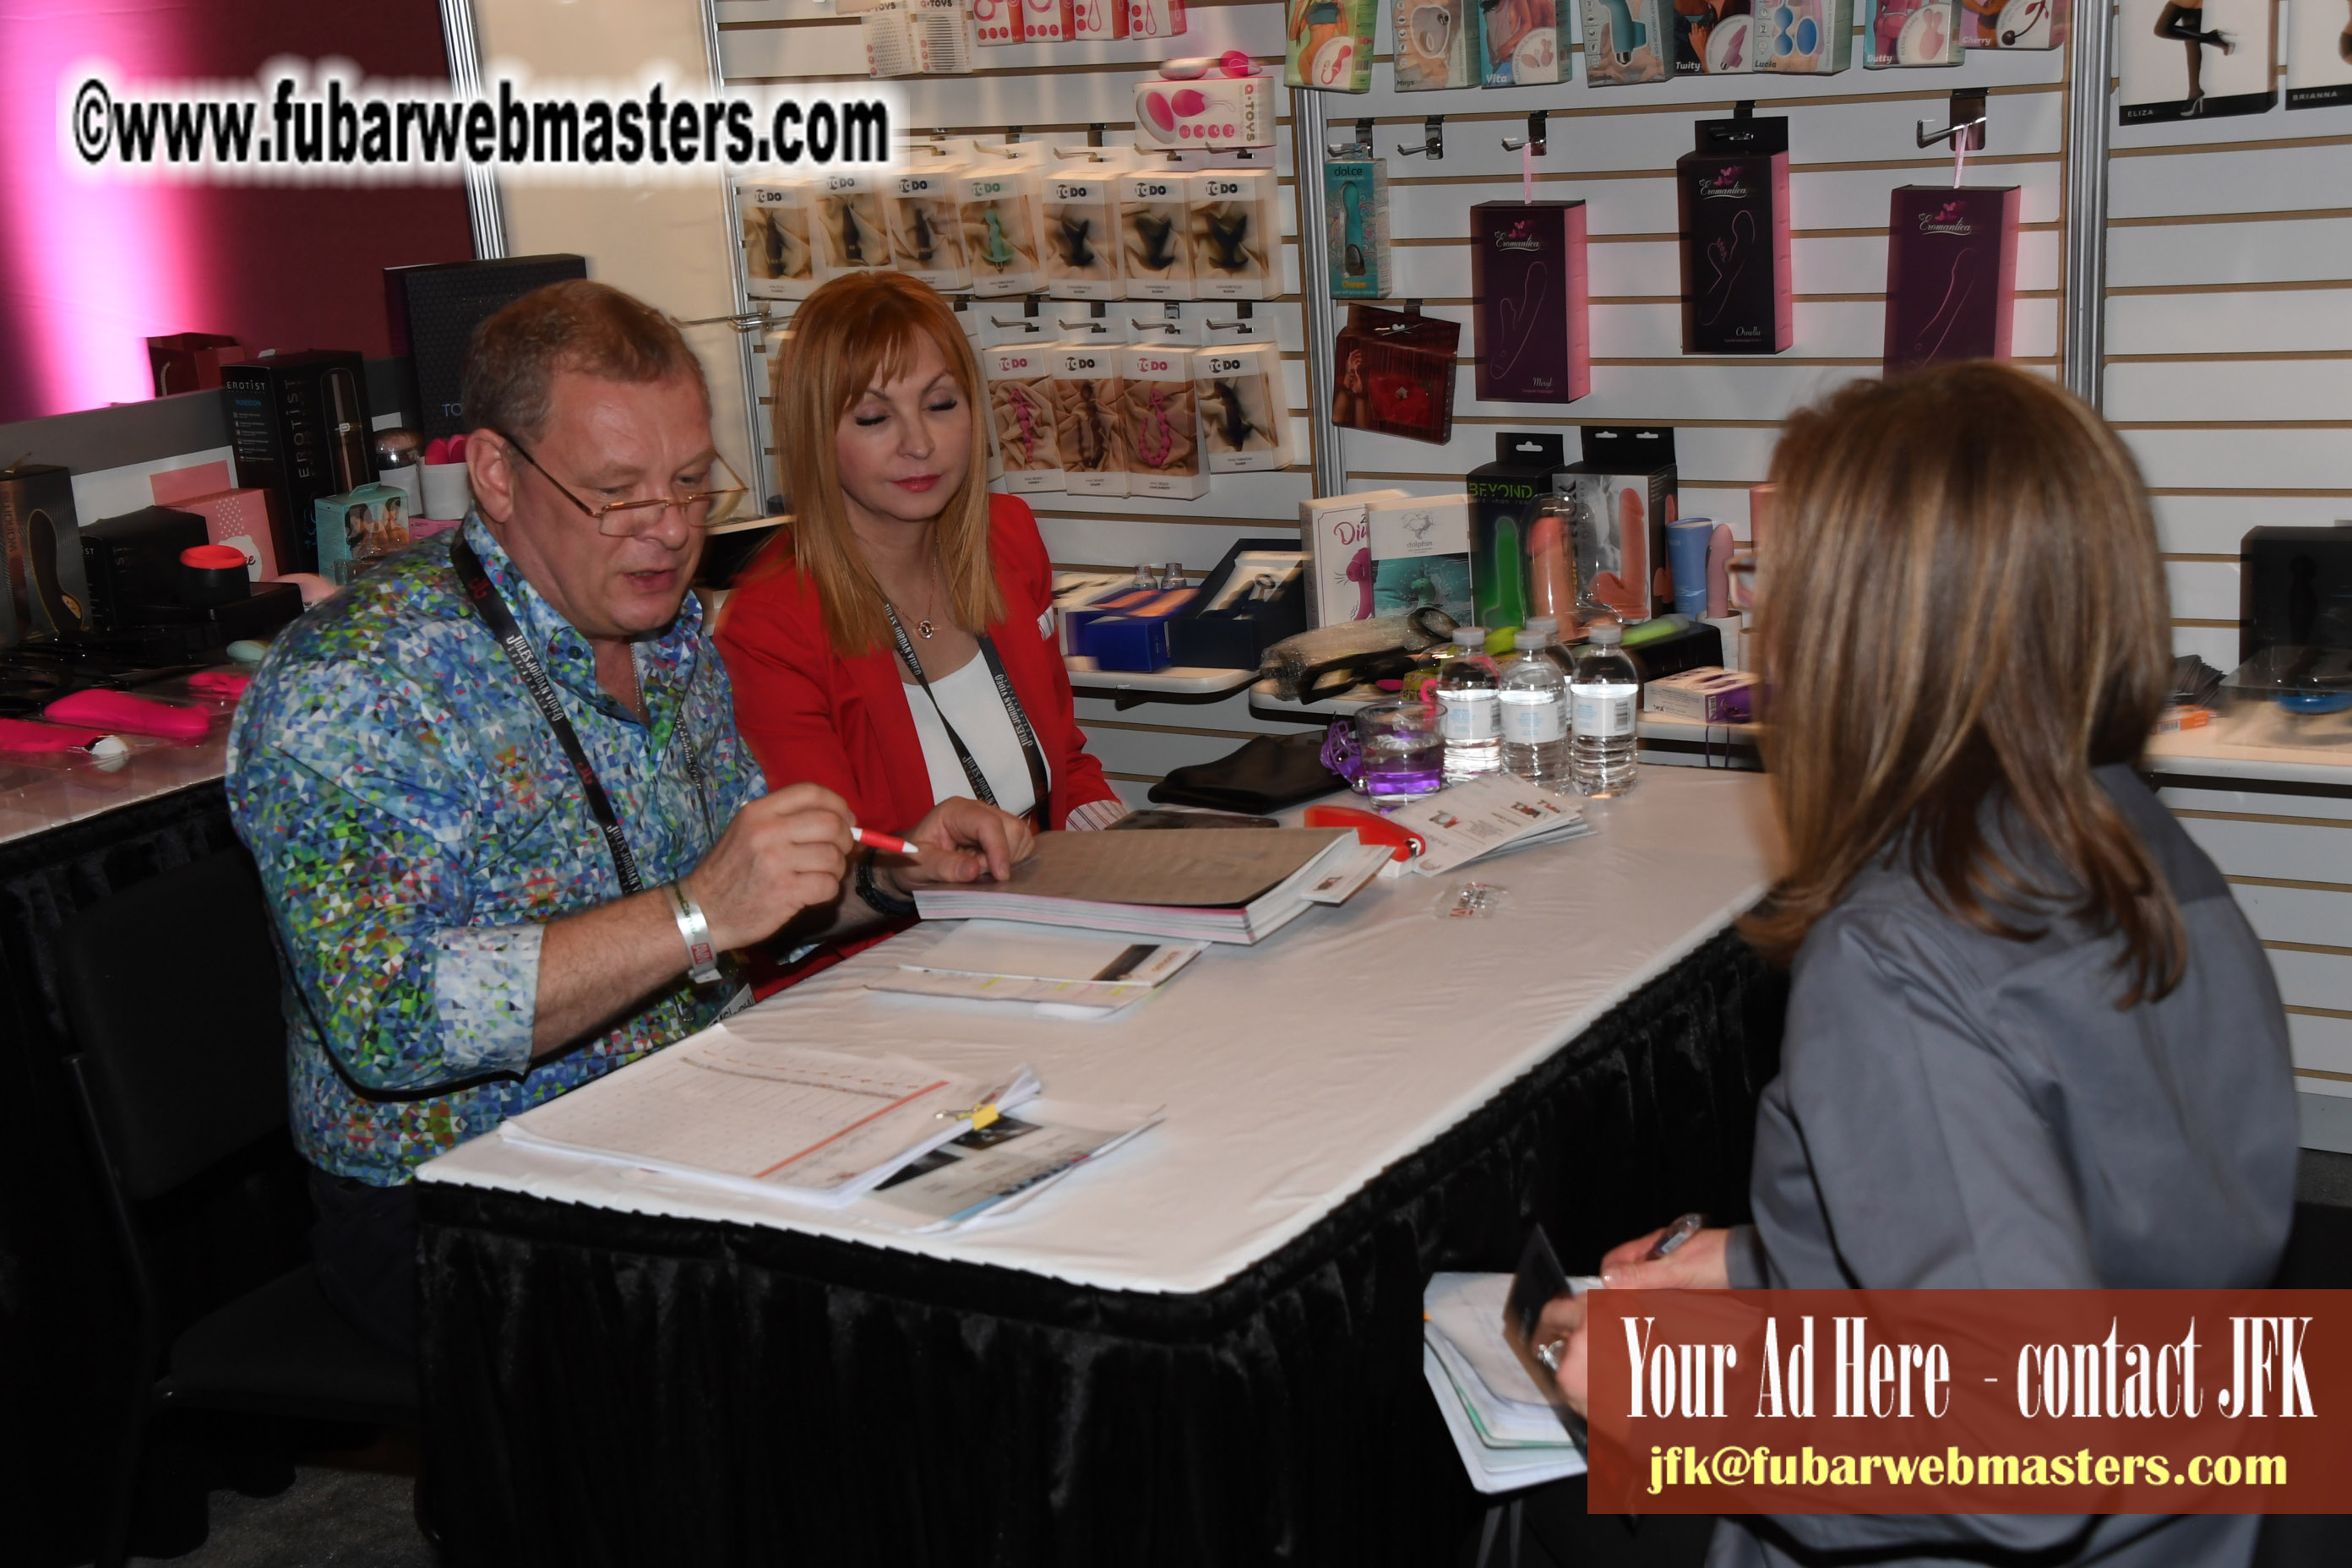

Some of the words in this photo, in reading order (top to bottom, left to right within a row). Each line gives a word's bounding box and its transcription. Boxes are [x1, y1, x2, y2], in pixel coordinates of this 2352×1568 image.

[1962, 36, 1991, 46] Cherry
[1675, 60, 1701, 73] Twity
[1755, 59, 1777, 69] Lucia
[1866, 54, 1892, 64] Dutty
[1485, 73, 1507, 84] Vita
[2292, 90, 2339, 101] BRIANNA
[2127, 109, 2154, 118] ELIZA
[1334, 166, 1363, 177] dolce
[1698, 178, 1747, 198] Eromantica
[1919, 213, 1972, 233] Eromantica
[1494, 231, 1540, 249] Eromantica
[1469, 482, 1533, 498] BEYOND
[1407, 540, 1433, 549] dolphin
[905, 651, 923, 677] VIDEO
[506, 631, 533, 665] JULES
[525, 659, 551, 695] JORDAN
[542, 692, 563, 721] VIDEO
[994, 672, 1010, 697] VIDEO
[1003, 696, 1021, 725] JORDAN
[1014, 721, 1033, 748] JULES
[961, 754, 982, 779] JULES
[975, 776, 996, 805] JORDAN
[607, 823, 626, 852] JULES
[619, 851, 639, 885] JORDAN
